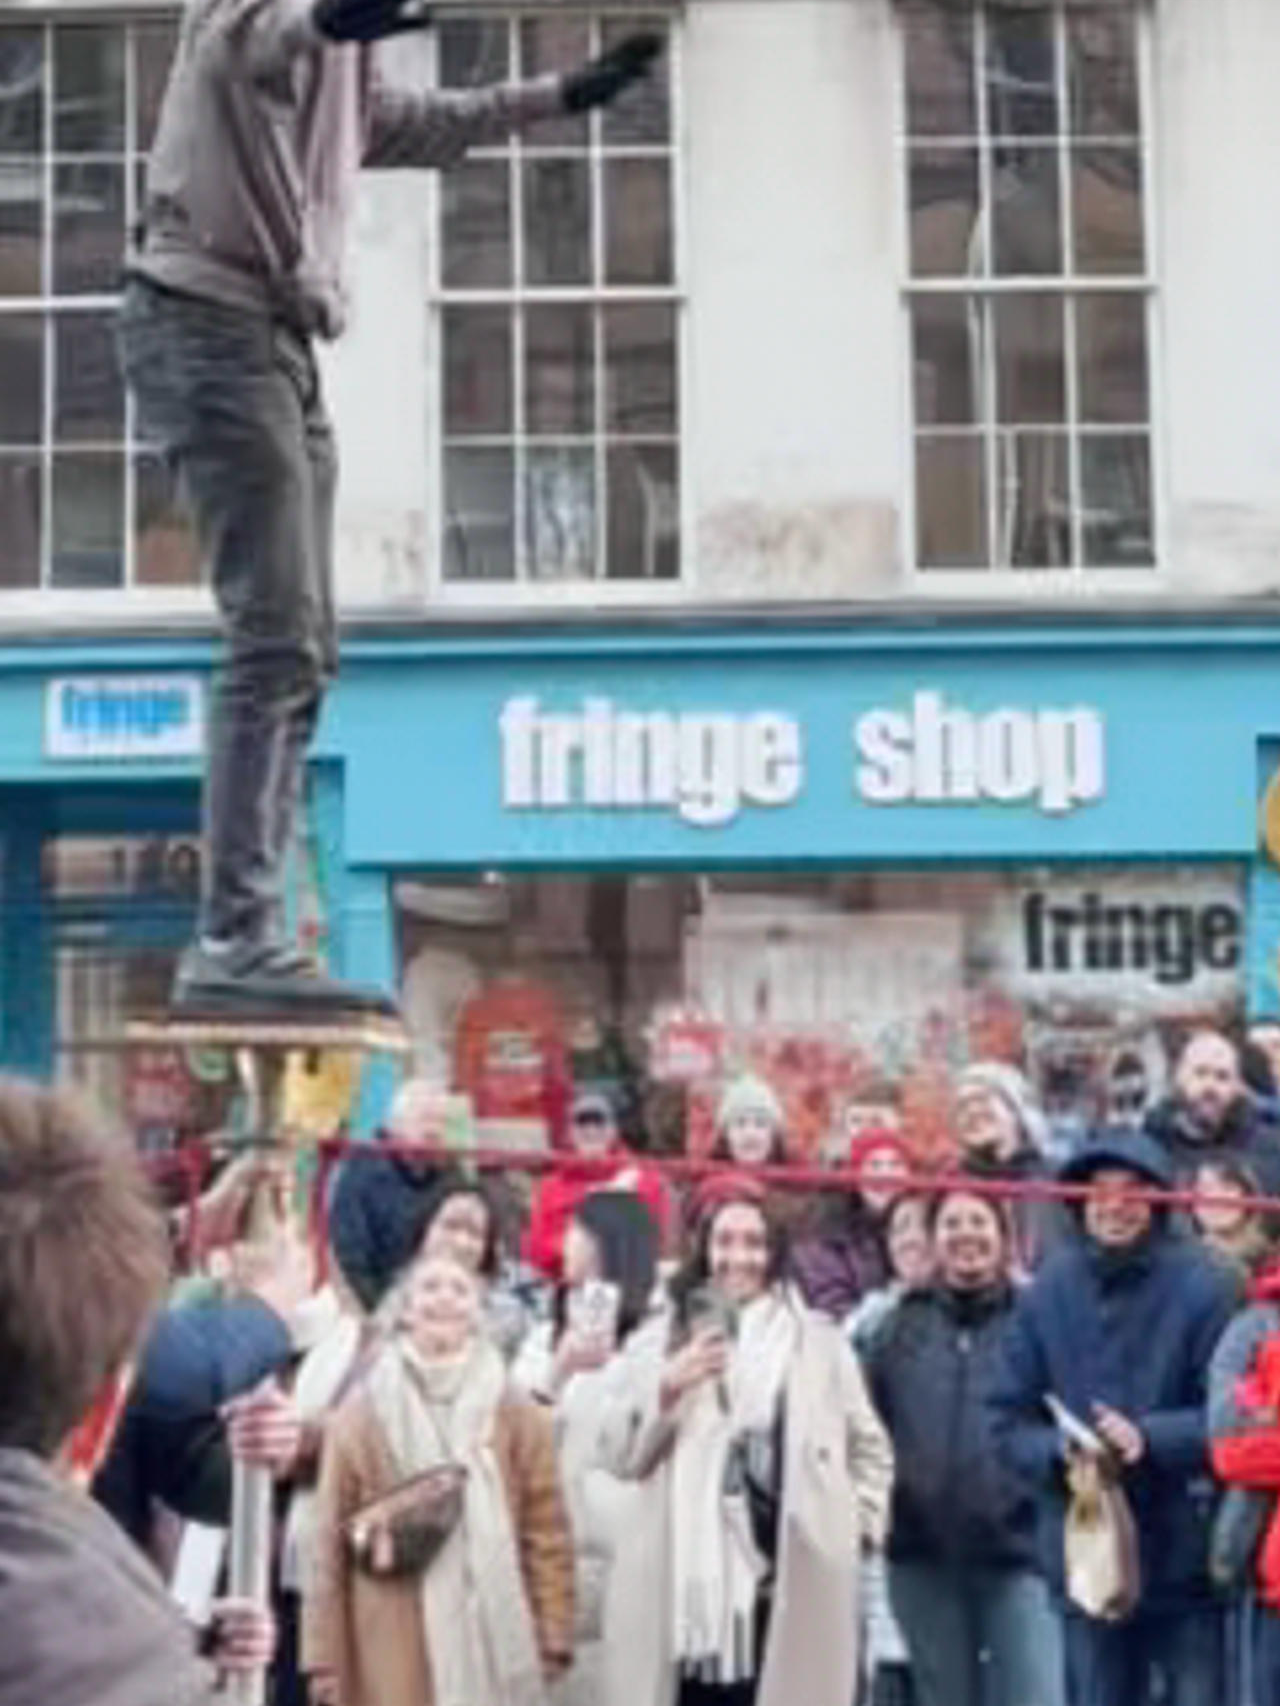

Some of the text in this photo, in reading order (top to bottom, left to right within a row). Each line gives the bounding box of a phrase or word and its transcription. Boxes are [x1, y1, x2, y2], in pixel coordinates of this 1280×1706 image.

[498, 690, 1106, 826] fringe shop
[1022, 890, 1240, 986] fringe
